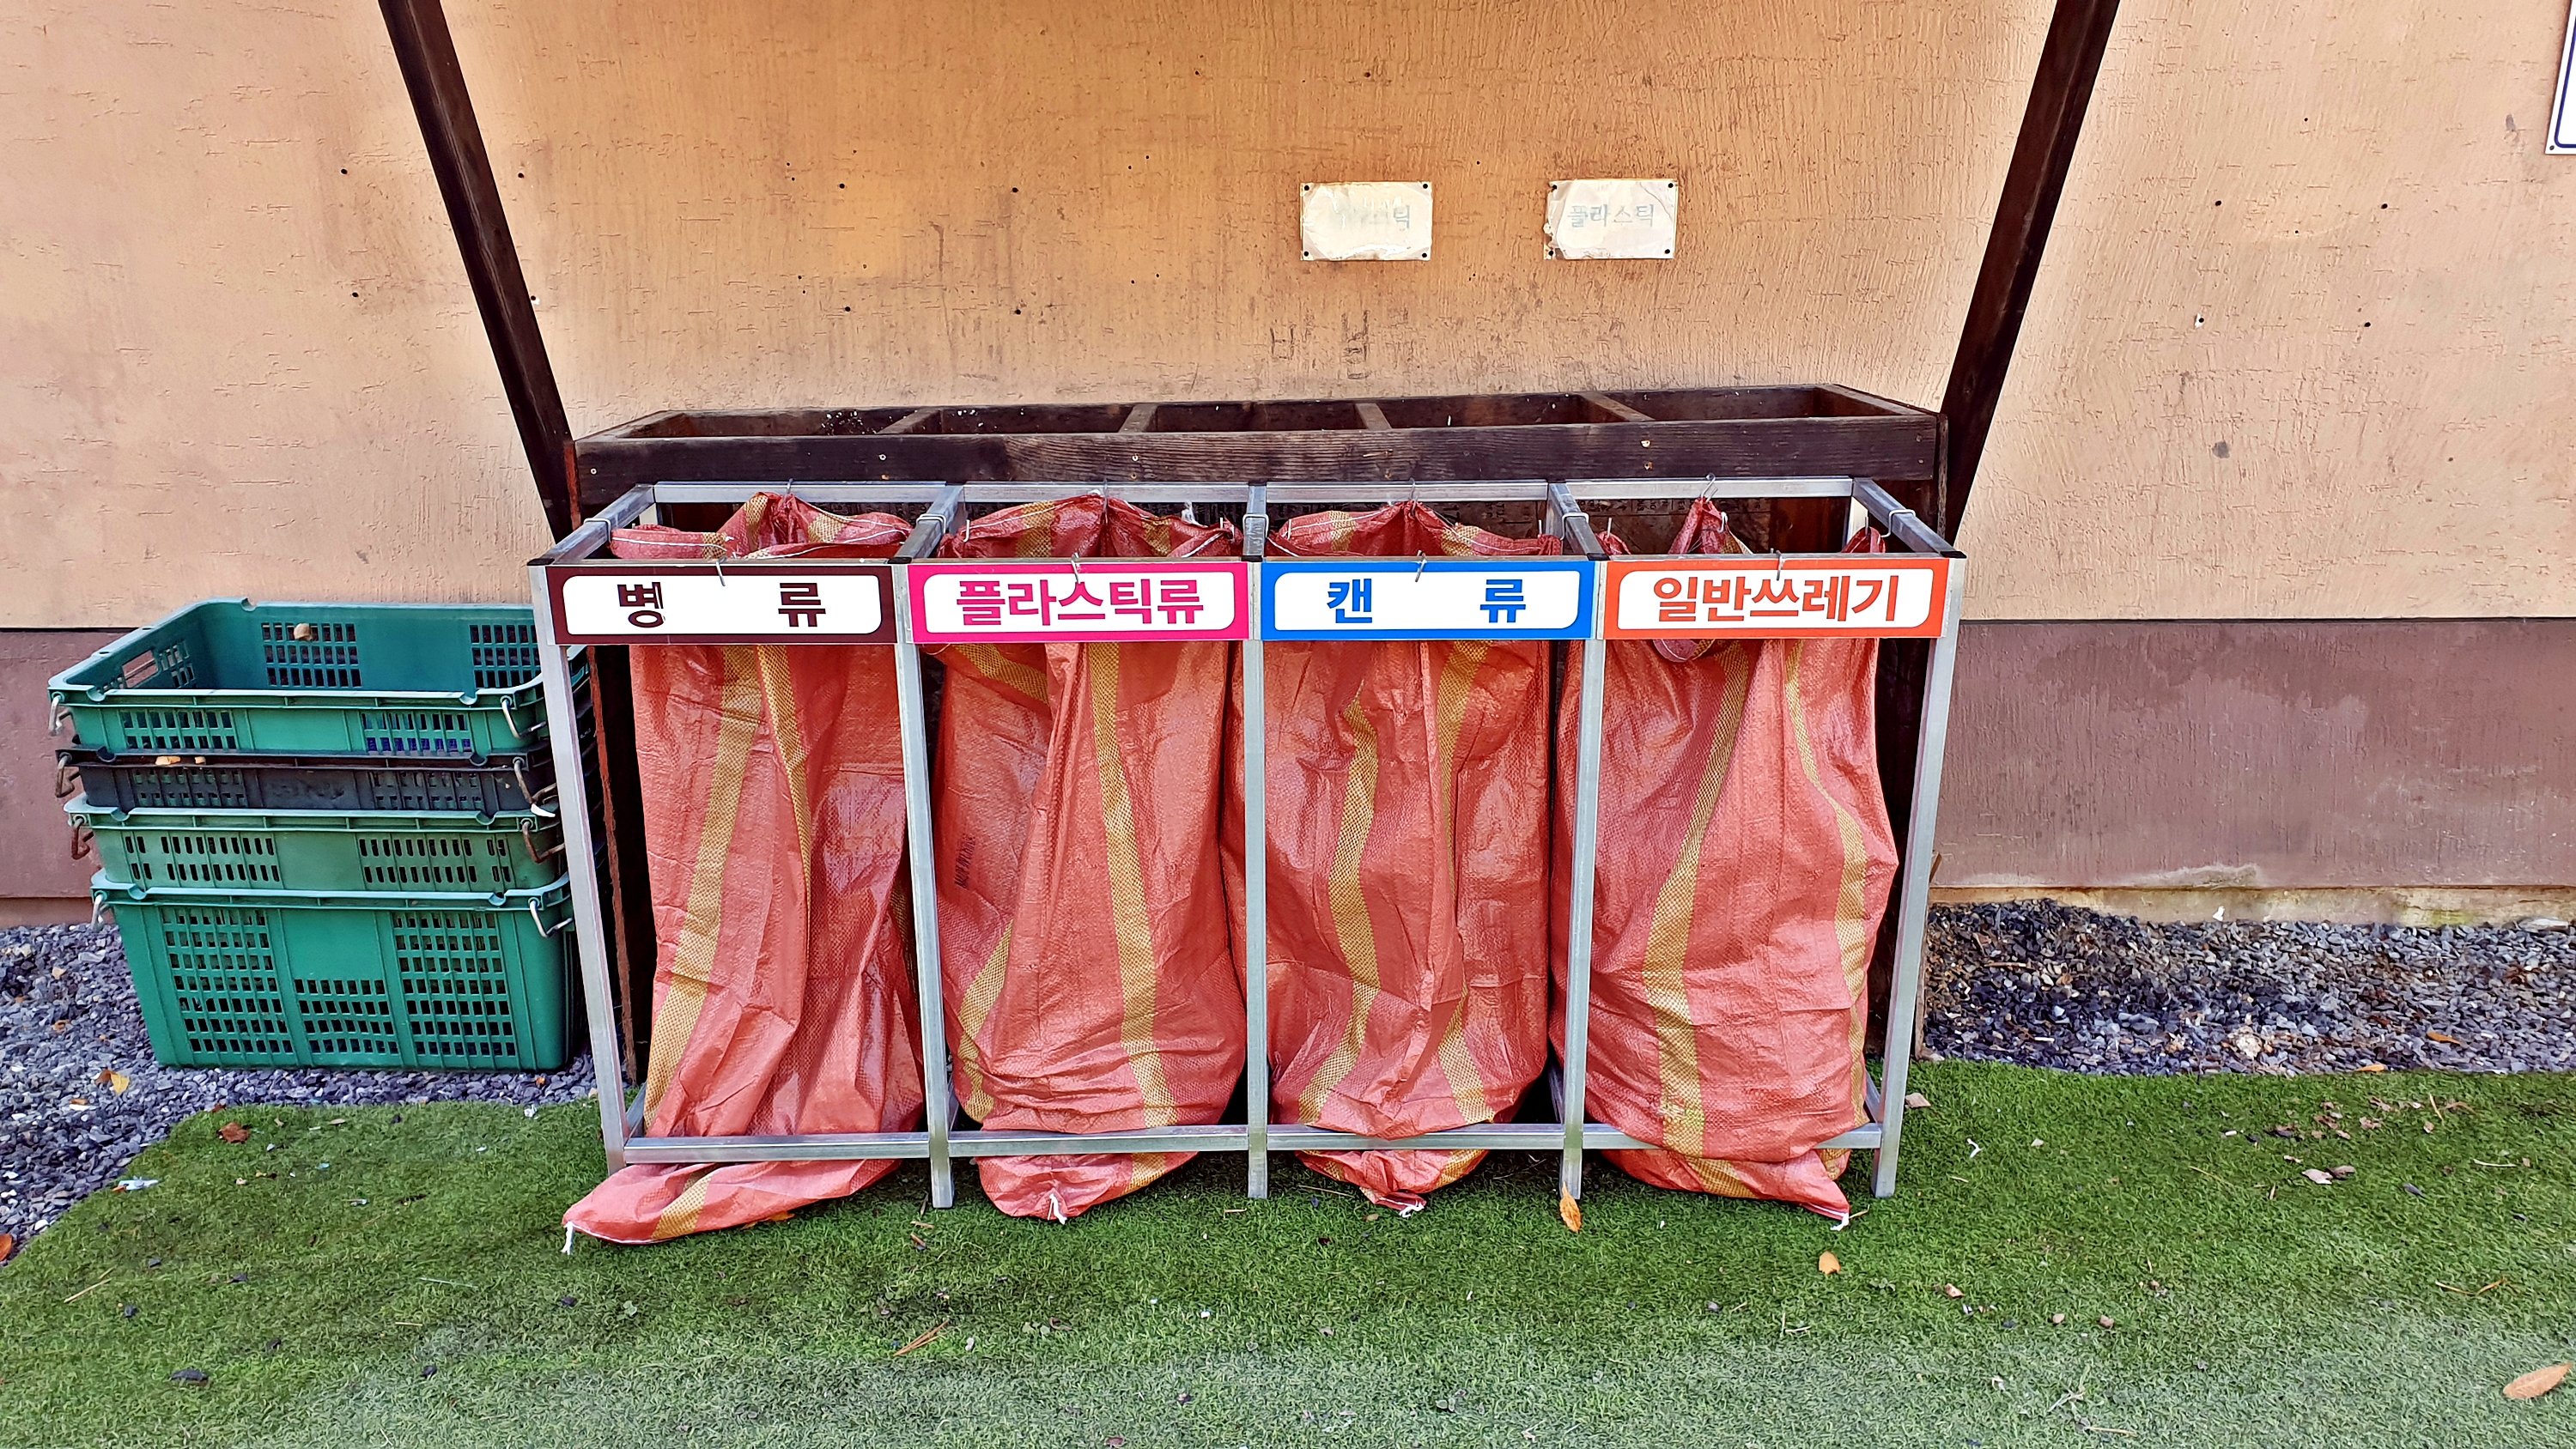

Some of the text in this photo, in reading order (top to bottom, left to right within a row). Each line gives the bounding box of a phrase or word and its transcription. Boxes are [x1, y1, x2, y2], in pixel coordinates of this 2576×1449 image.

[1567, 203, 1654, 227] 플라스틱
[617, 581, 826, 628] 병 류
[956, 579, 1204, 627] 플라스틱류
[1327, 578, 1527, 625] 캔 류
[1653, 574, 1899, 622] 일반쓰레기
